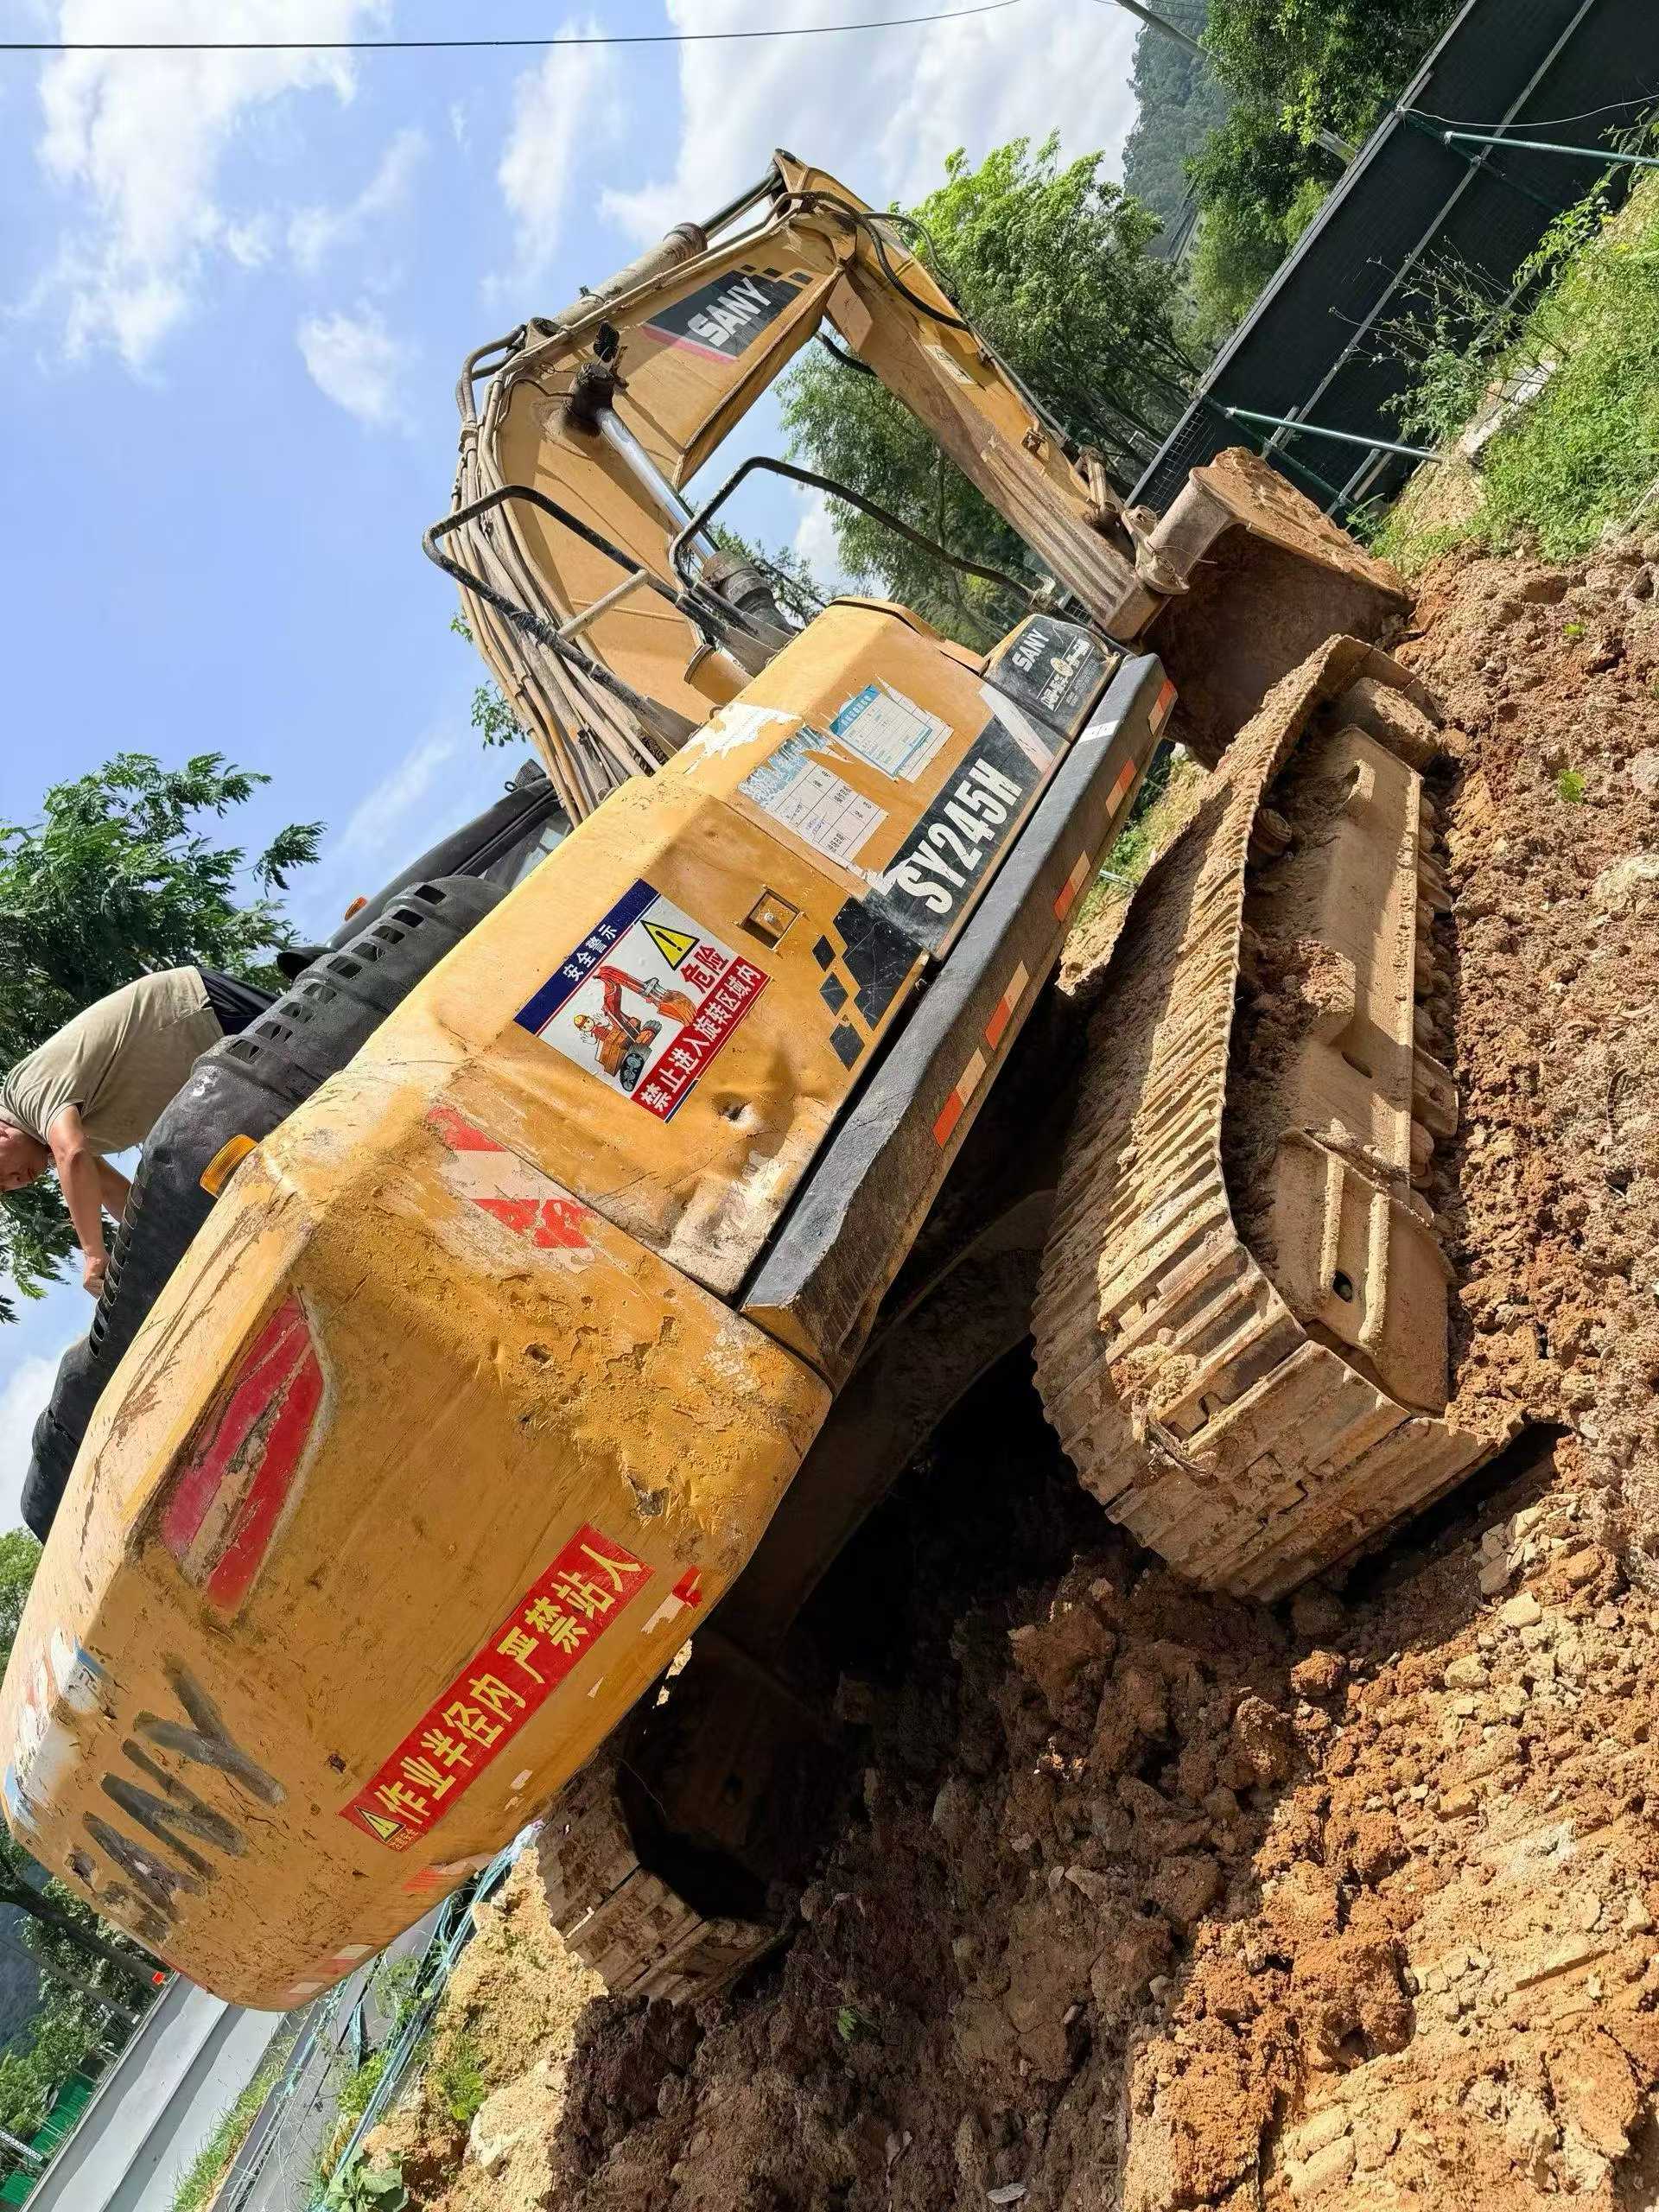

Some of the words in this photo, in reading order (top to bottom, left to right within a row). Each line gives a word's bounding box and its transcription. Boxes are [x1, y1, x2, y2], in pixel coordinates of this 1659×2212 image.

[687, 276, 772, 346] SANY
[1012, 628, 1050, 672] SANY
[896, 758, 1023, 914] SY245H
[563, 924, 618, 982] 安全警示
[679, 944, 730, 995] 危险
[639, 964, 761, 1113] 禁止进入旋转区域内
[373, 1673, 527, 1825] 作业半径内
[497, 1543, 643, 1684] 严禁站人
